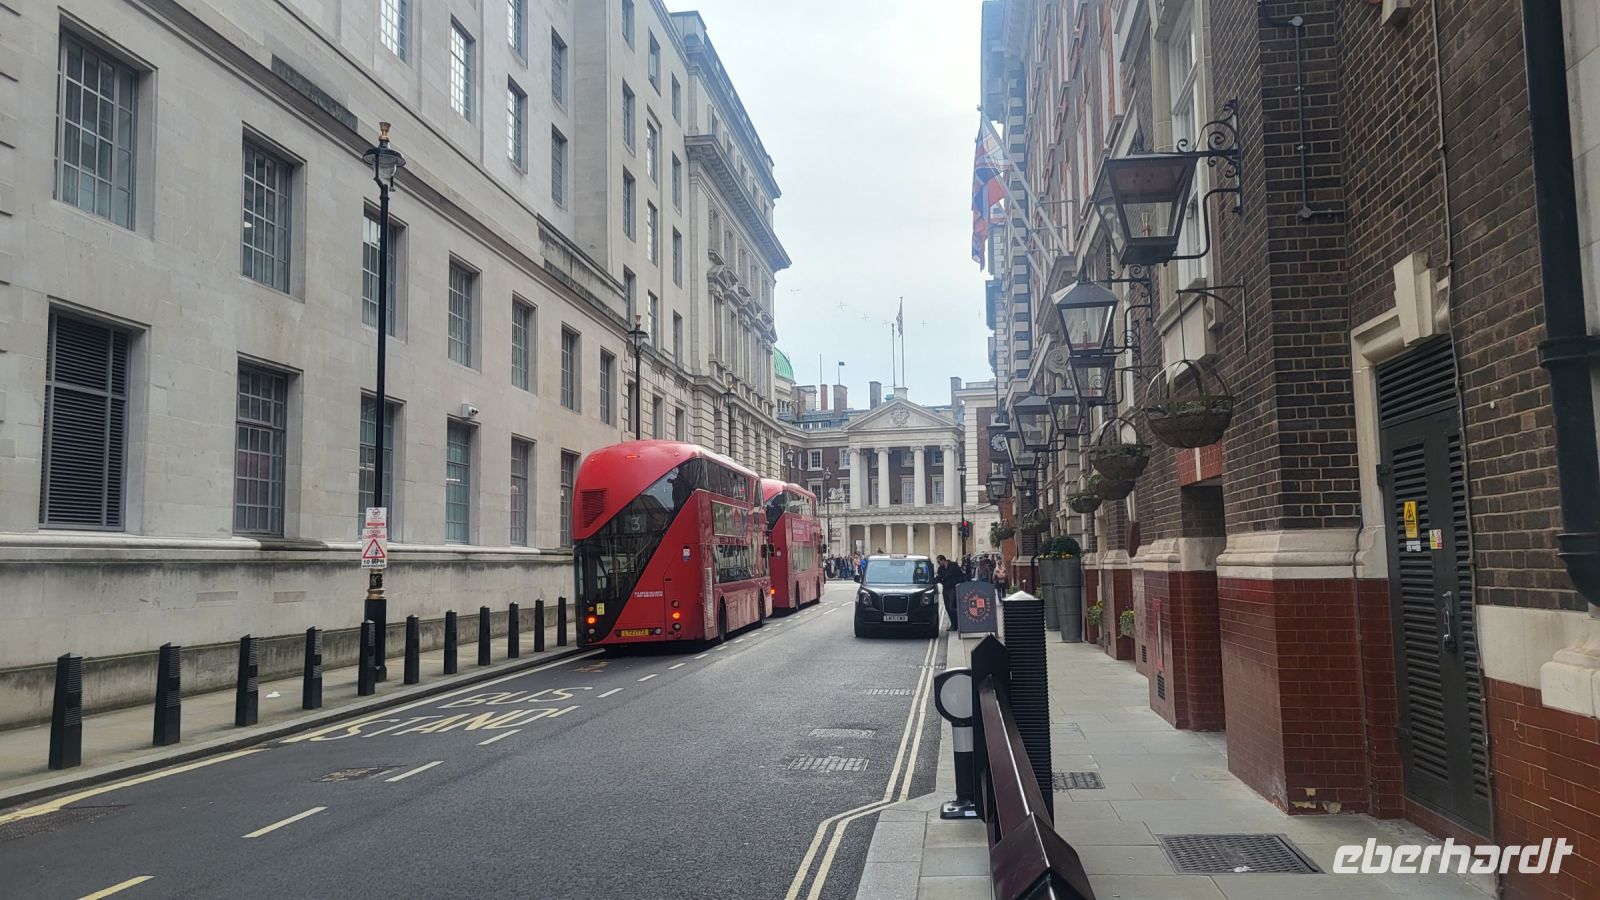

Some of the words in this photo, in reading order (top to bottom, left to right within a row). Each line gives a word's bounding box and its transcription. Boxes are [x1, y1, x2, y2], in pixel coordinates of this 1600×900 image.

[631, 516, 640, 531] 3
[437, 686, 593, 708] BUS
[310, 705, 581, 742] STAND
